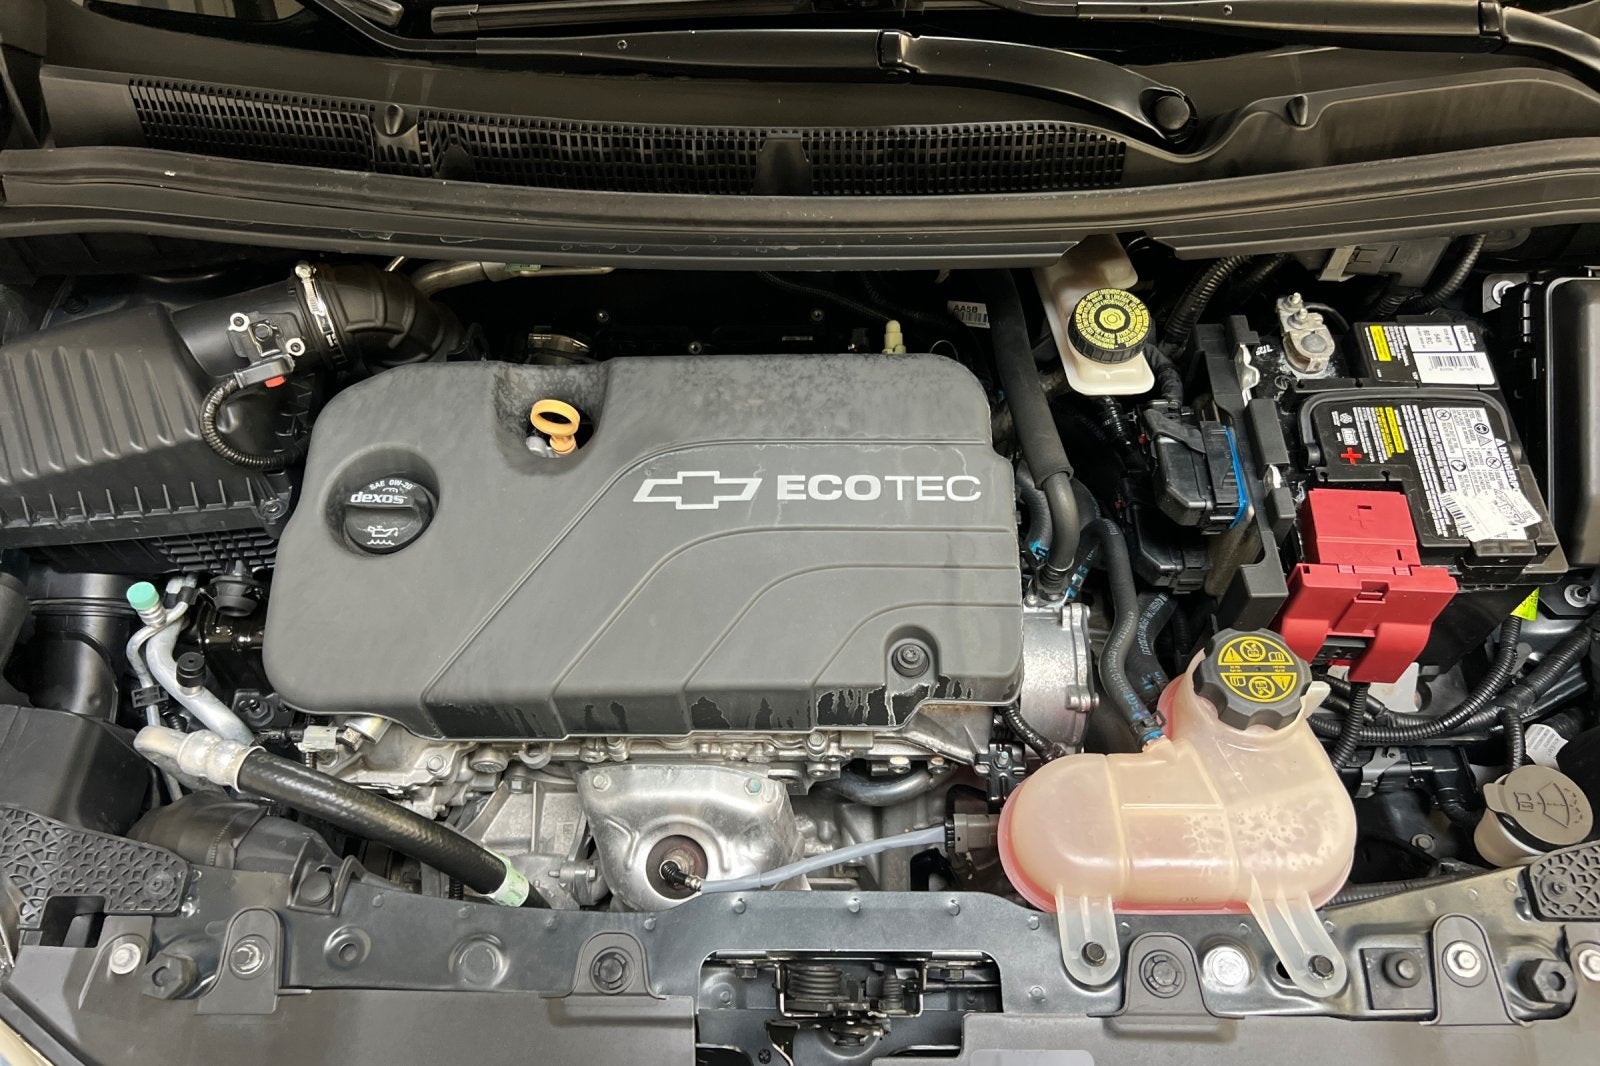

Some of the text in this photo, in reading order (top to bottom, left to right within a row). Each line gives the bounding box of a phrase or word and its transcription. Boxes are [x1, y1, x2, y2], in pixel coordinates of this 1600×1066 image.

[369, 480, 385, 490] SAE
[776, 474, 982, 502] ECOTEC
[350, 491, 407, 504] dexos
